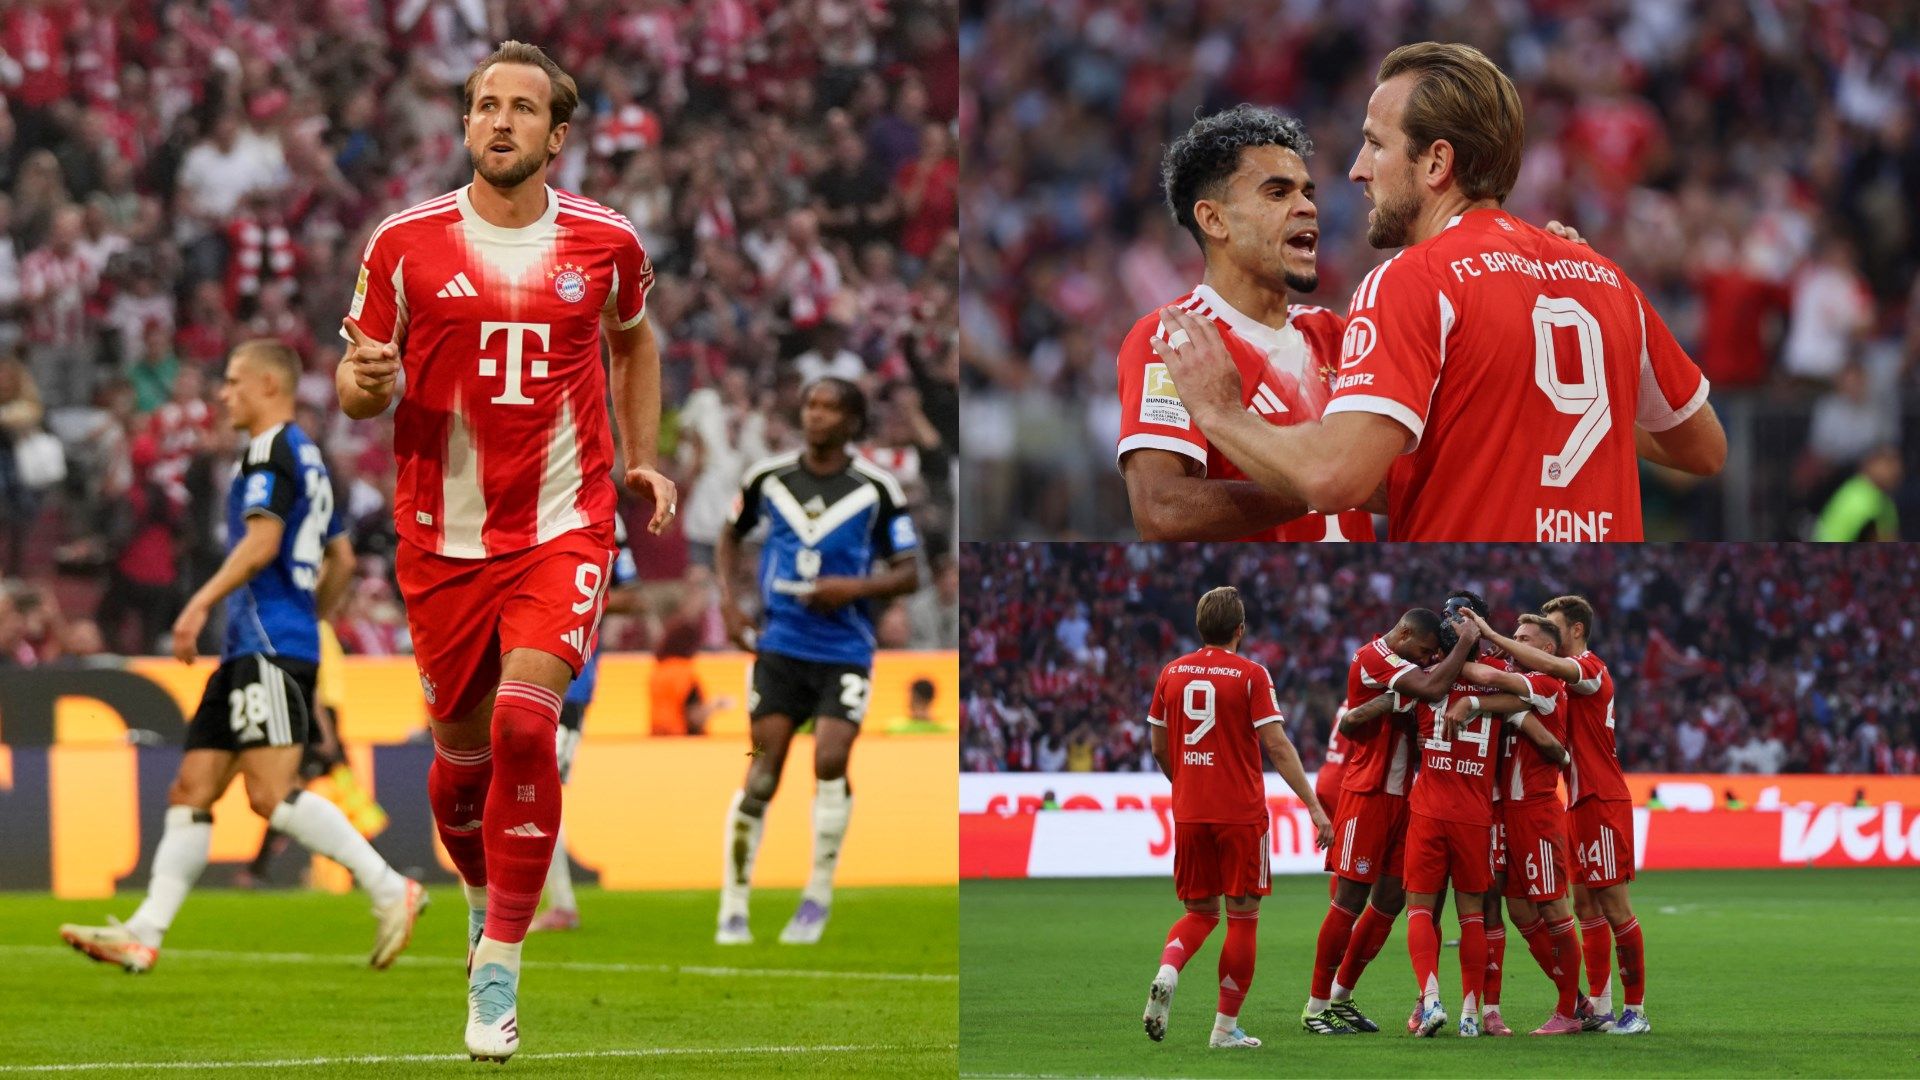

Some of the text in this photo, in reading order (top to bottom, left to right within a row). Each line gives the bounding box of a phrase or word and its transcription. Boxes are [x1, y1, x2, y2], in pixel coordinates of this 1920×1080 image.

[1450, 251, 1621, 290] FC BAYERN MÜNCHEN
[1145, 398, 1184, 407] BUNDESLIG
[1532, 294, 1612, 488] 9
[571, 562, 602, 616] 9
[1169, 664, 1242, 678] FC BAYERN MÜNCHEN
[228, 682, 269, 731] 28
[1183, 680, 1216, 745] 9
[1425, 698, 1492, 757] 14
[1184, 751, 1215, 766] KANE
[1427, 755, 1485, 776] LUIS DÍAZ
[1526, 852, 1538, 880] 6
